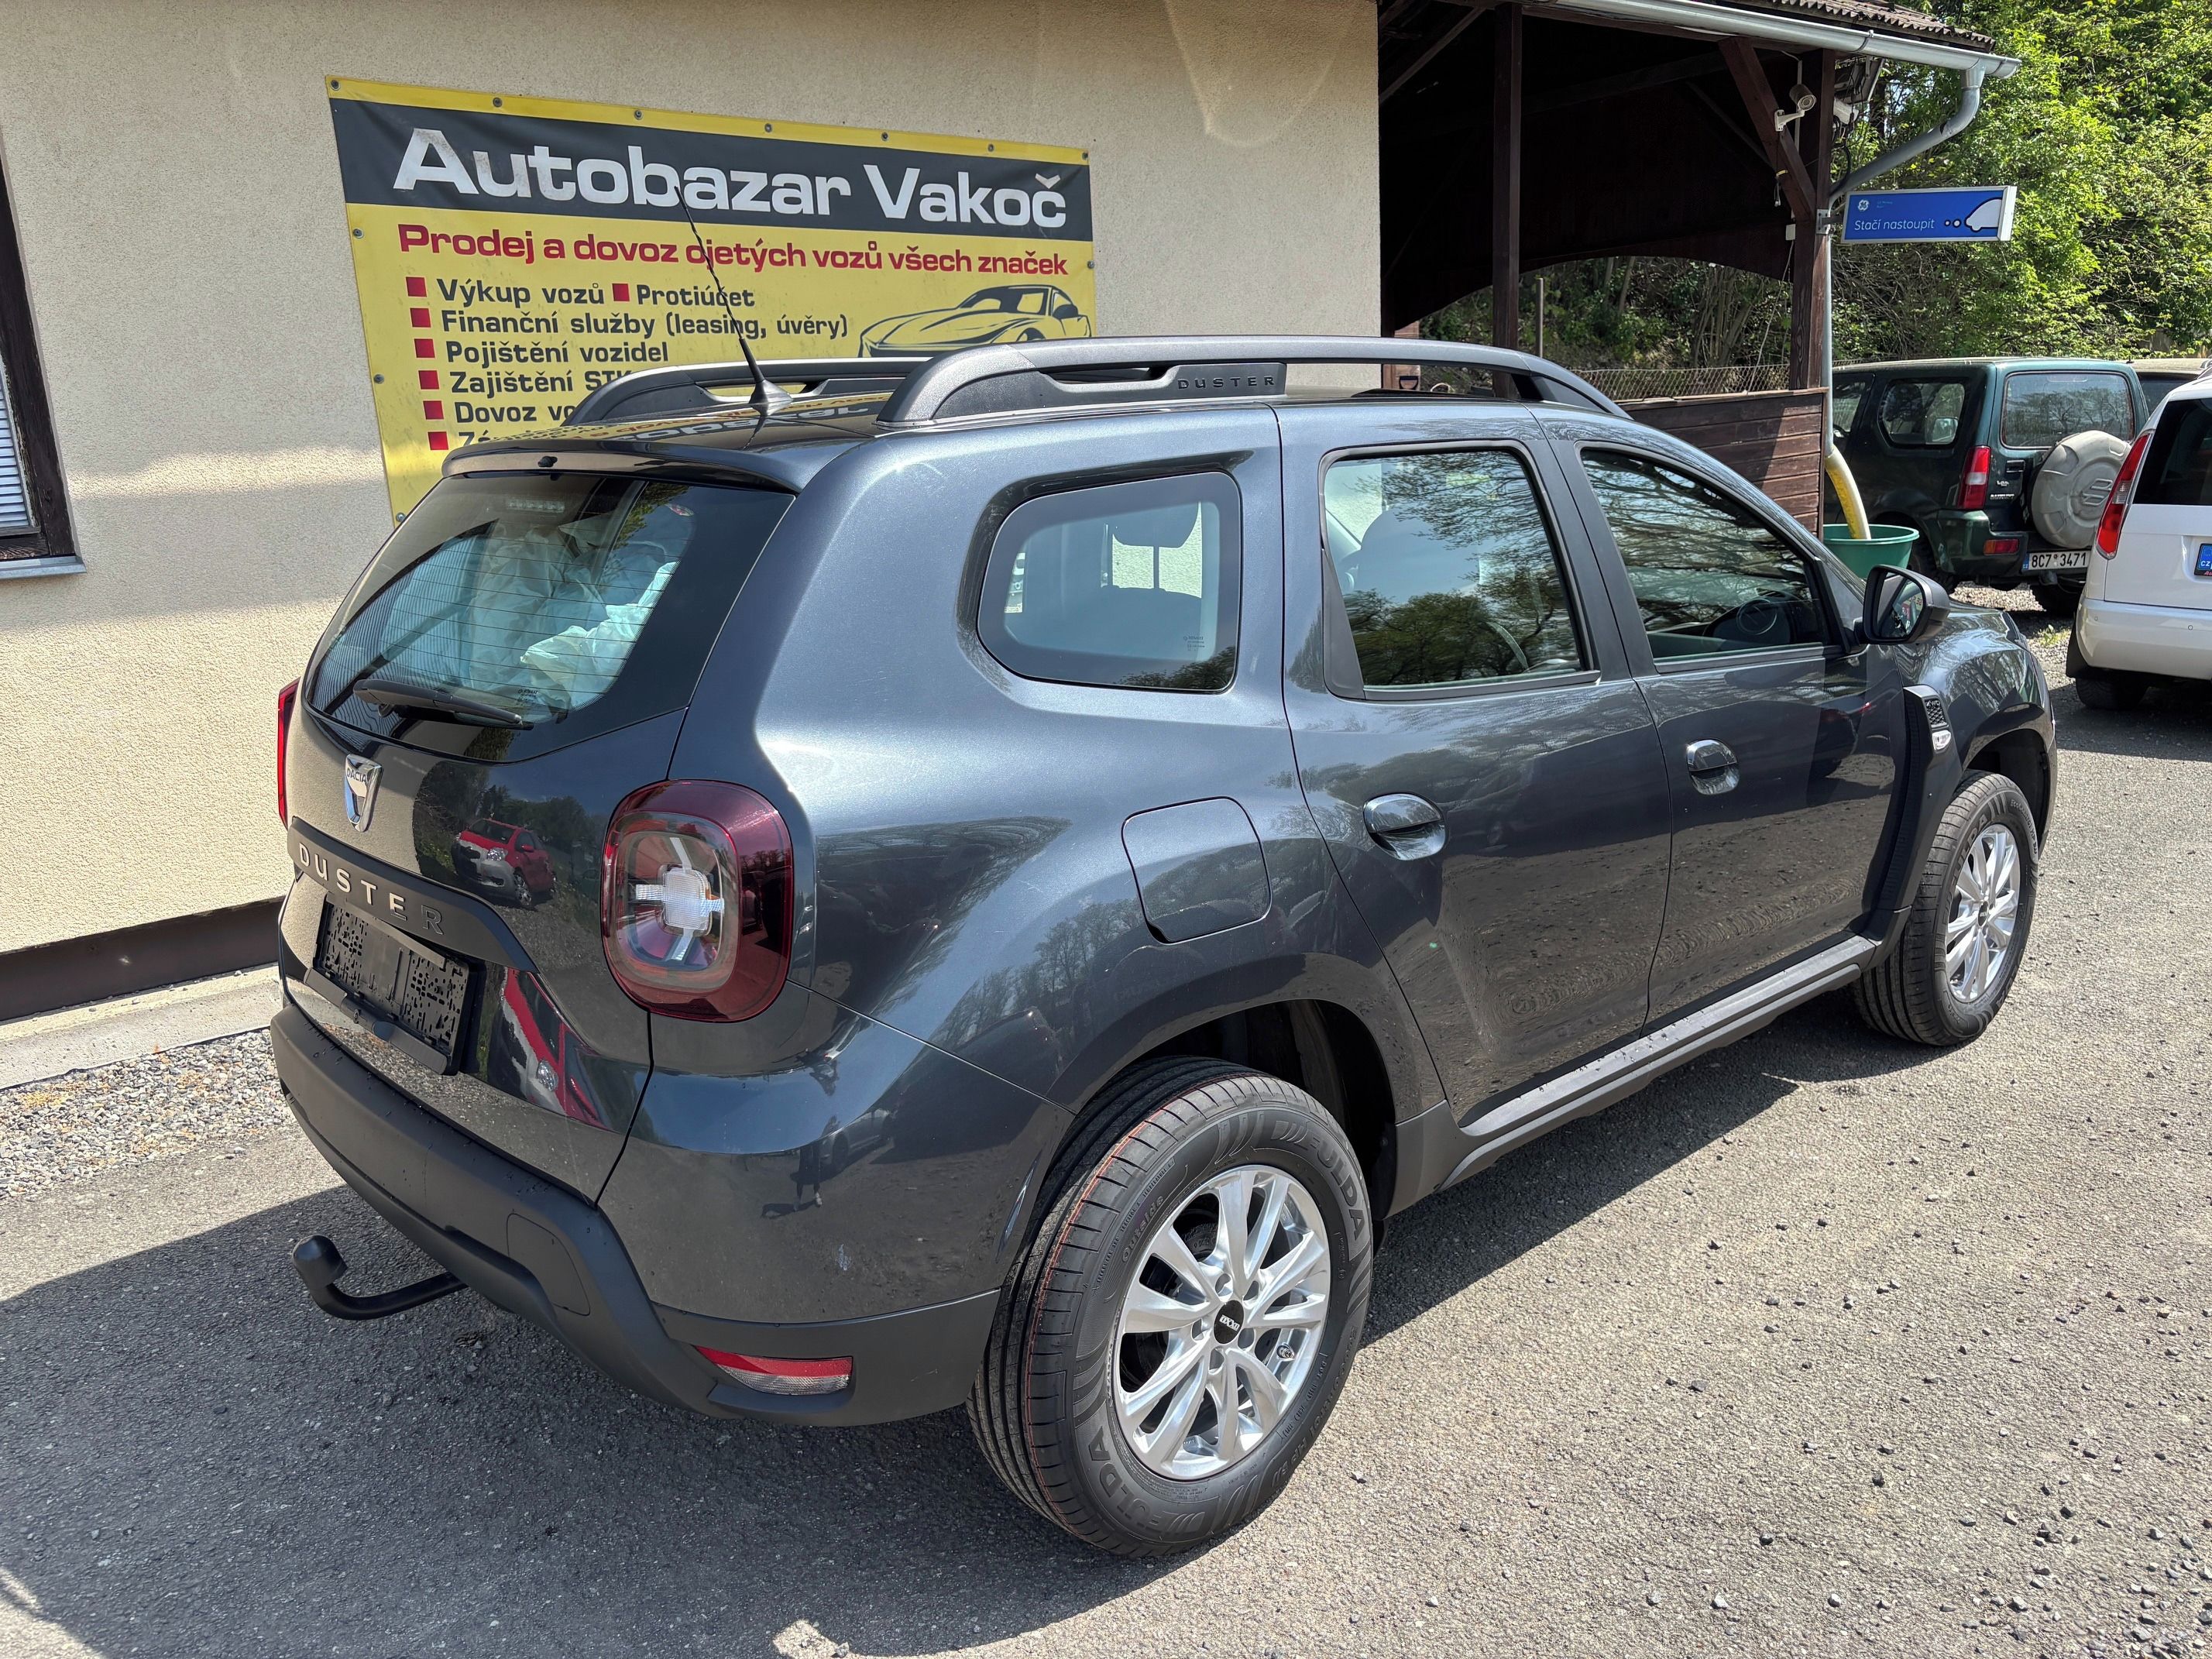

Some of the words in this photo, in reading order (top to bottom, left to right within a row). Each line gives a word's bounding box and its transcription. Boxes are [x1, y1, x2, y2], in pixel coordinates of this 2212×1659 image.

[393, 128, 851, 216] Autobazar
[863, 164, 1067, 228] Vakoč
[1854, 218, 1881, 231] Stačí
[1883, 218, 1935, 232] nastoupit
[397, 223, 535, 264] Prodej
[544, 239, 566, 259] a
[573, 234, 678, 263] dovoz
[685, 239, 806, 273] ojetých
[812, 240, 883, 270] vozů
[888, 246, 972, 273] všech
[978, 250, 1069, 276] značek
[436, 279, 532, 308] Výkup
[541, 282, 605, 305] vozů
[637, 283, 756, 307] Protiúčet
[441, 310, 559, 334] Finanční
[570, 312, 655, 339] služby
[666, 312, 767, 340] (leasing,
[777, 314, 849, 340] úvěry)
[445, 340, 569, 369] Pojištění
[579, 342, 668, 362] vozidel
[449, 369, 574, 400] Zajištění
[1176, 376, 1276, 390] DUSTER
[454, 401, 538, 424] Dovoz
[2032, 554, 2052, 568] 8C7
[2059, 553, 2087, 566] 3471
[346, 767, 368, 783] DACIA
[298, 841, 444, 936] DUSTER
[1121, 1195, 1164, 1264] Outside
